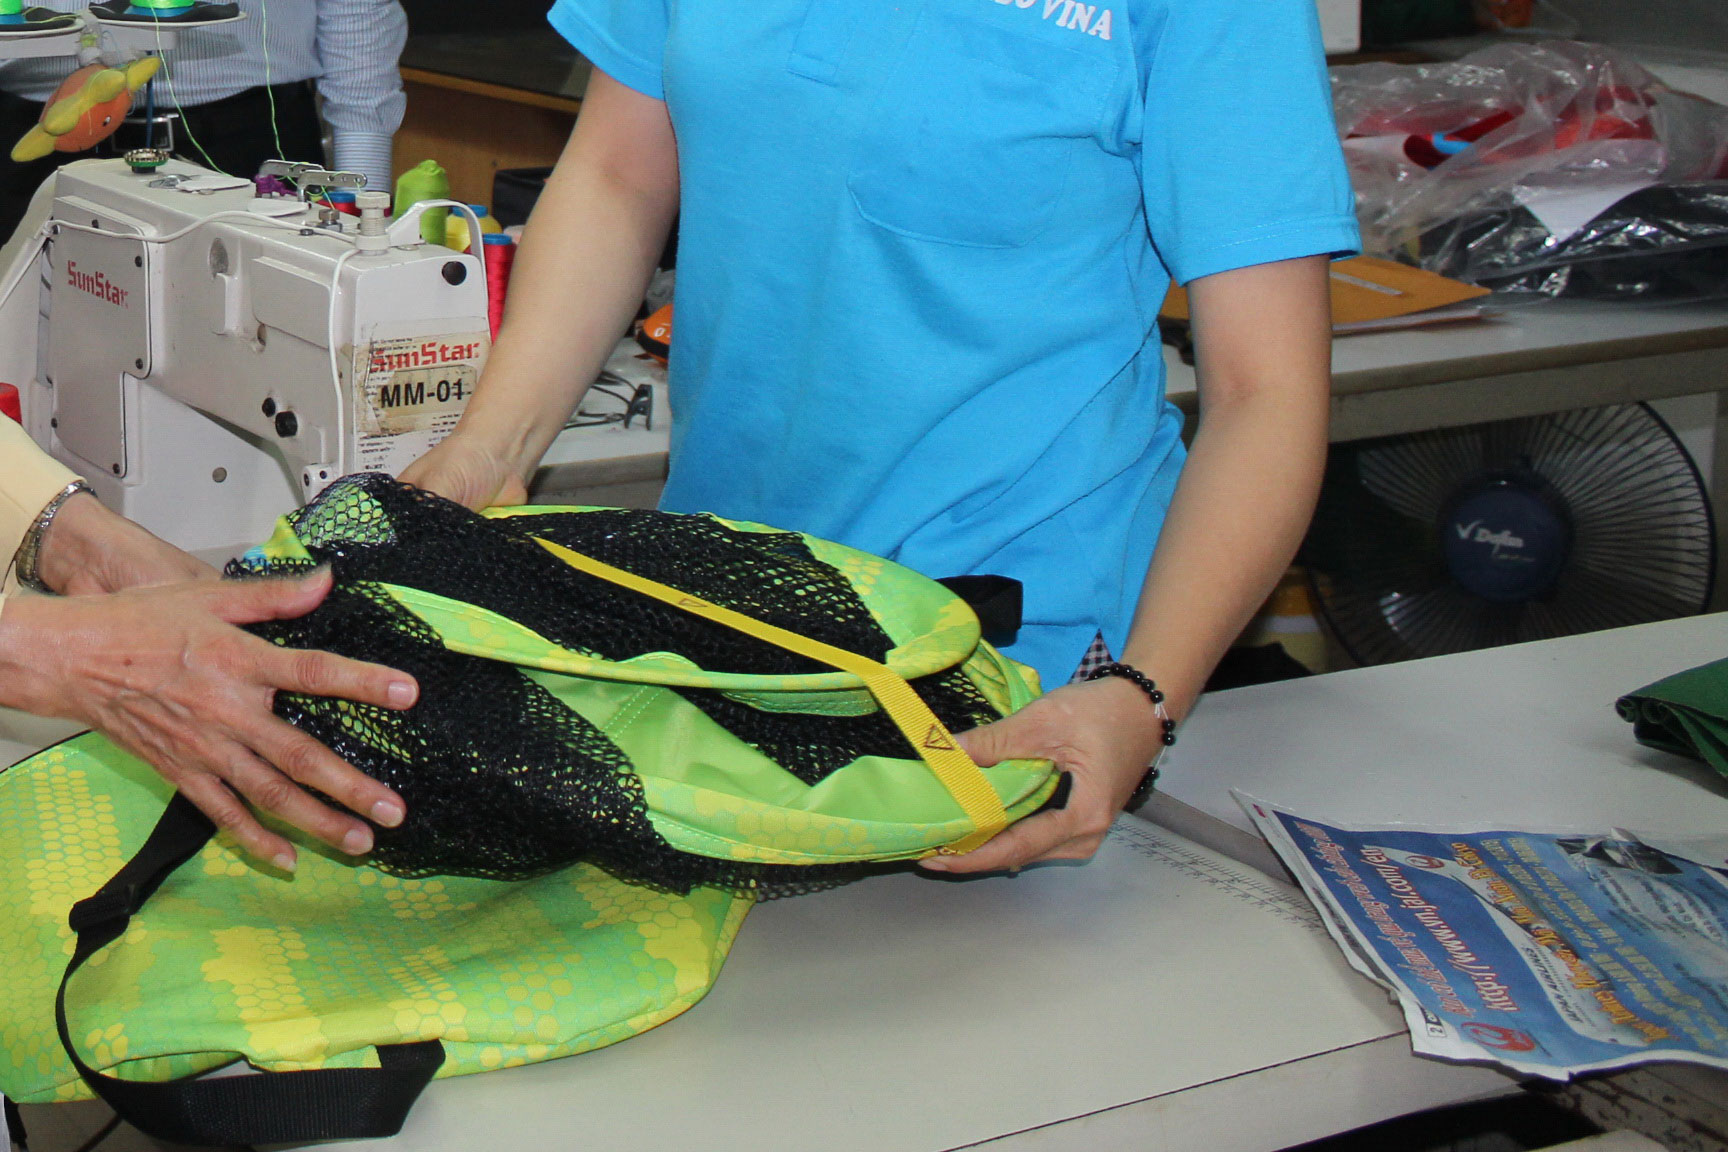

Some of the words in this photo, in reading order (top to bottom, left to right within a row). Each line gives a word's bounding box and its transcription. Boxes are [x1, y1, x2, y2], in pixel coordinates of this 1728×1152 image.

[66, 259, 130, 309] SunStar
[370, 341, 481, 375] SunStar
[380, 378, 464, 410] MM-01
[1359, 847, 1521, 1012] http://www.vn.jal.com/en
